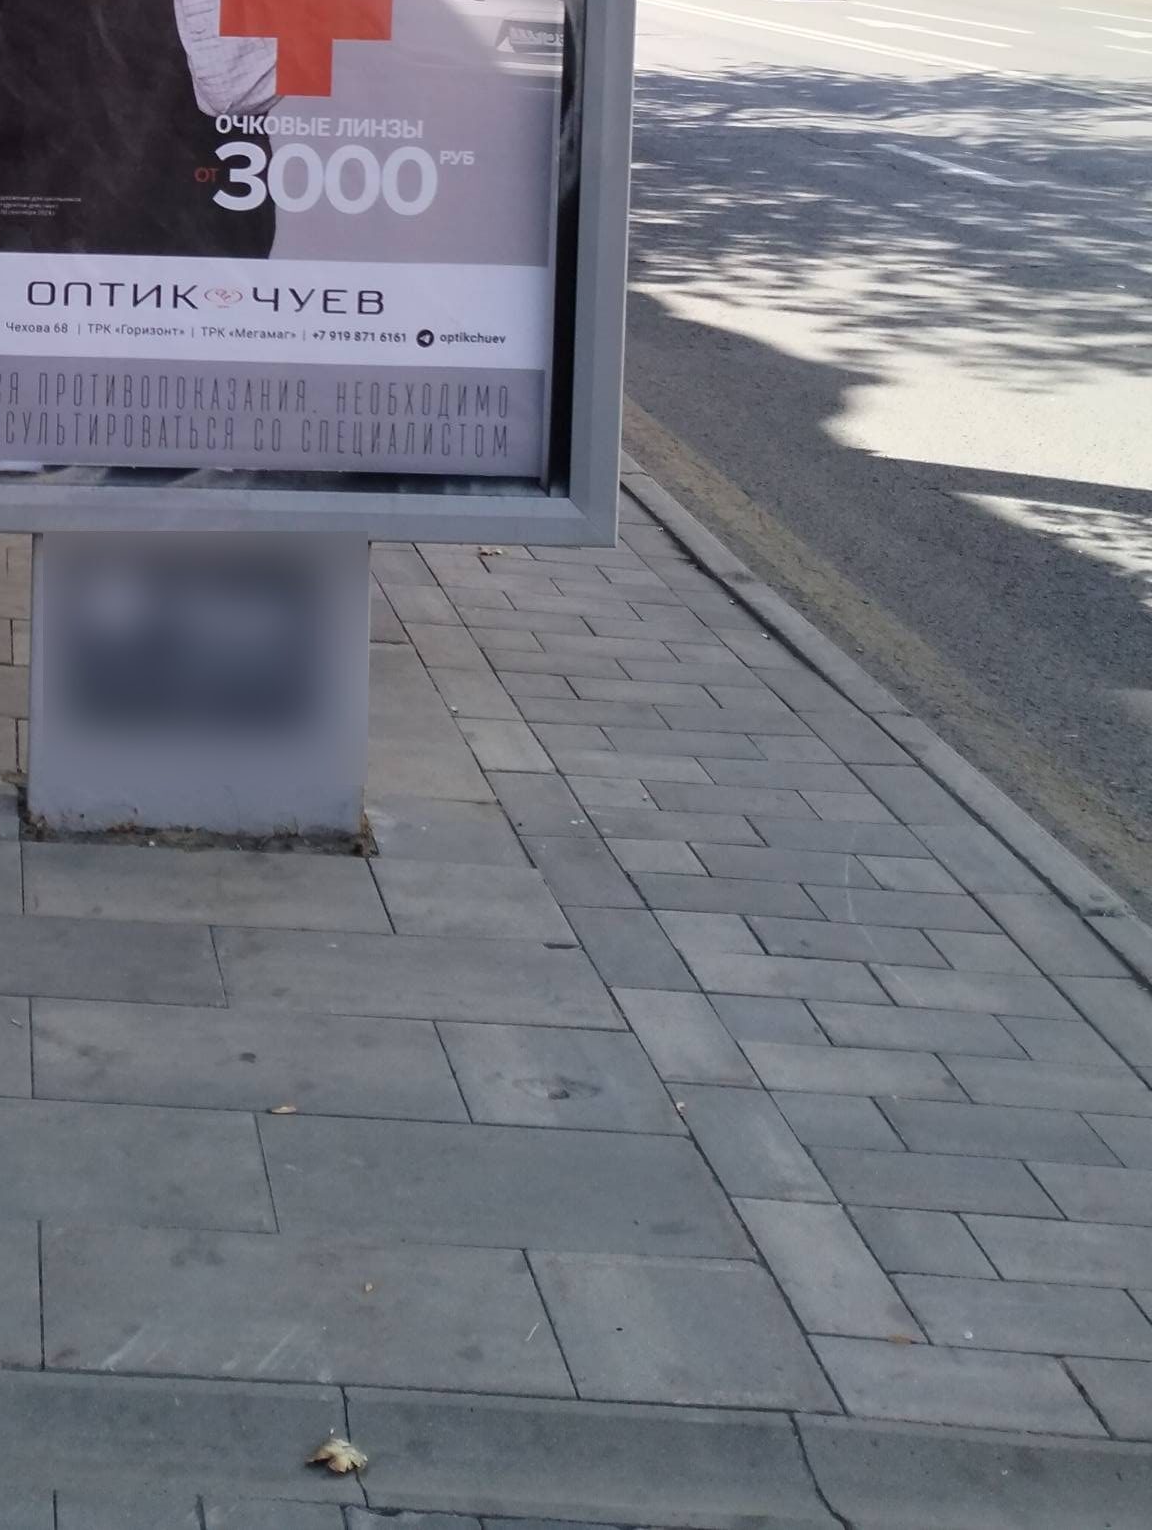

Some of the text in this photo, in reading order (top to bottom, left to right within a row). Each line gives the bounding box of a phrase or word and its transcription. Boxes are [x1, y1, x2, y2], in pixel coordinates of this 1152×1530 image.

[215, 114, 424, 139] ОЧКОВЫЕ ЛИНЗЫ
[212, 141, 438, 216] 3000
[439, 150, 475, 166] РУБ
[27, 280, 385, 316] ОПТИК ЧУЕВ
[5, 322, 50, 334] Чехова
[53, 323, 68, 334] 68
[87, 323, 111, 335] ТРК
[201, 326, 225, 338] ТРК
[311, 329, 327, 341] +7
[329, 330, 351, 342] 919
[354, 330, 376, 343] 871
[379, 331, 407, 343] 6161
[439, 331, 507, 345] optikchuev
[336, 381, 509, 419] НЕОБХОДИМО
[253, 418, 281, 452] СО
[301, 419, 509, 458] СПЕЦИАЛИСТОМ
